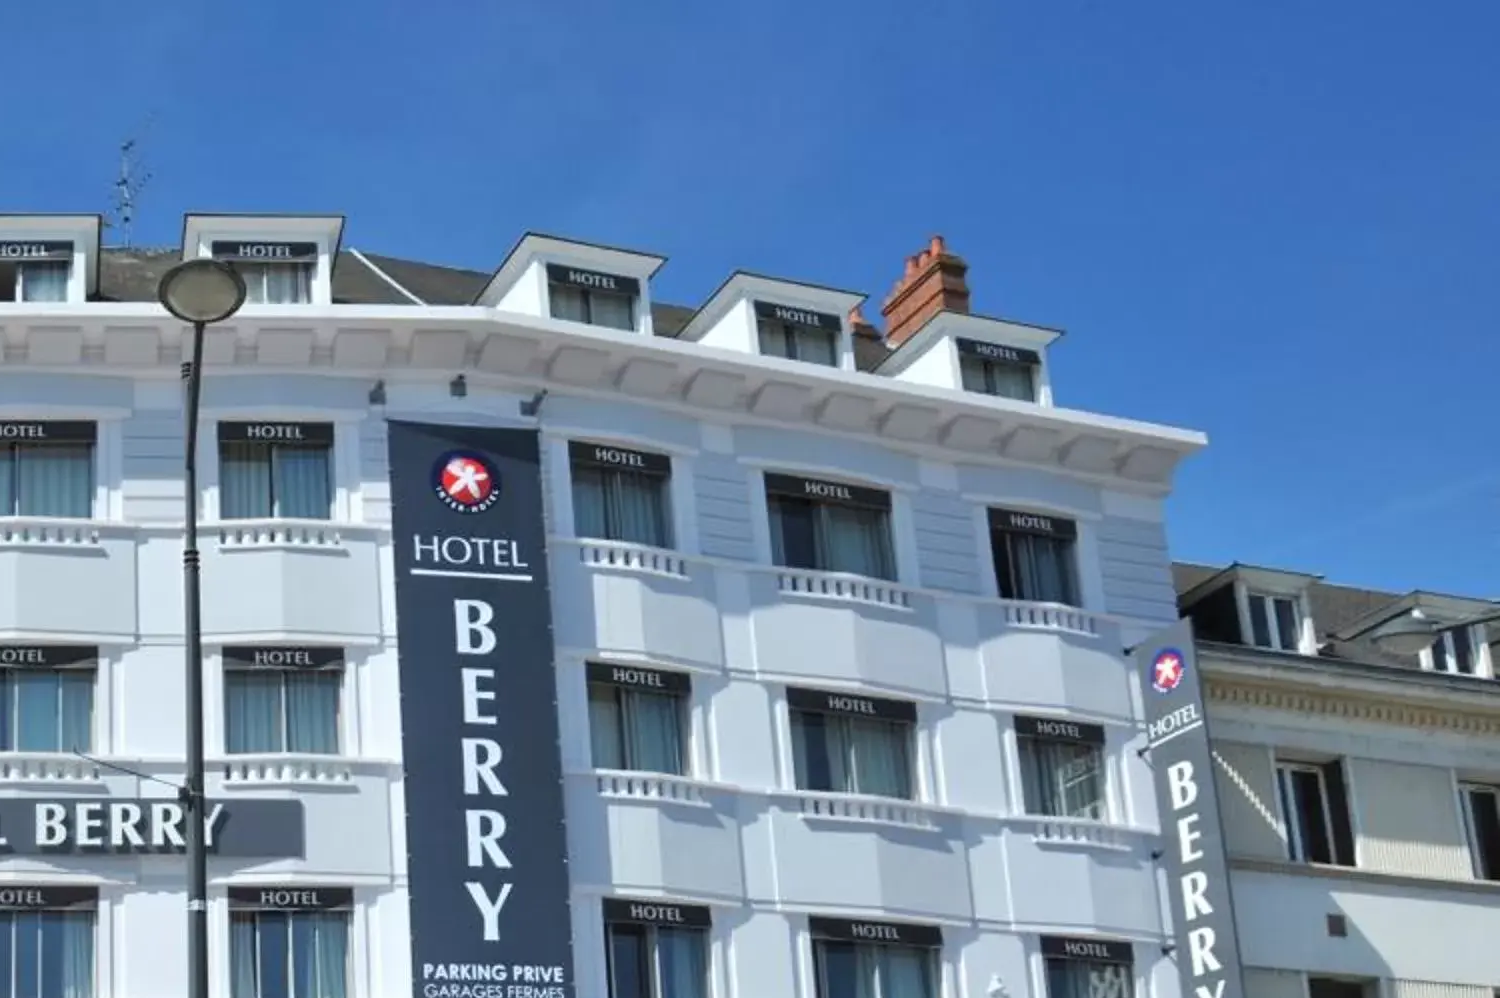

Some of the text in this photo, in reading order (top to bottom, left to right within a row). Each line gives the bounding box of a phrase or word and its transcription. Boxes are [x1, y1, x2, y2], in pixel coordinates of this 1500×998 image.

[239, 244, 292, 258] HOTEL
[569, 271, 617, 289] HOTEL
[776, 306, 820, 326] HOTEL
[976, 344, 1019, 361] HOTEL
[247, 425, 304, 439] HOTEL
[596, 449, 644, 467] HOTEL
[805, 481, 851, 500] HOTEL
[1010, 515, 1052, 531] HOTEL
[413, 533, 529, 567] HOTEL
[254, 650, 313, 666] HOTEL
[613, 668, 662, 687] HOTEL
[828, 697, 876, 715] HOTEL
[1037, 720, 1082, 739] HOTEL
[1149, 704, 1200, 740] HOTEL
[453, 598, 513, 941] BERRY
[260, 890, 321, 906] HOTEL
[630, 903, 682, 922] HOTEL
[852, 923, 900, 941] HOTEL
[1065, 941, 1110, 958] HOTEL
[423, 964, 565, 983] PARKING PRIVE
[424, 983, 503, 998] GARAGES
